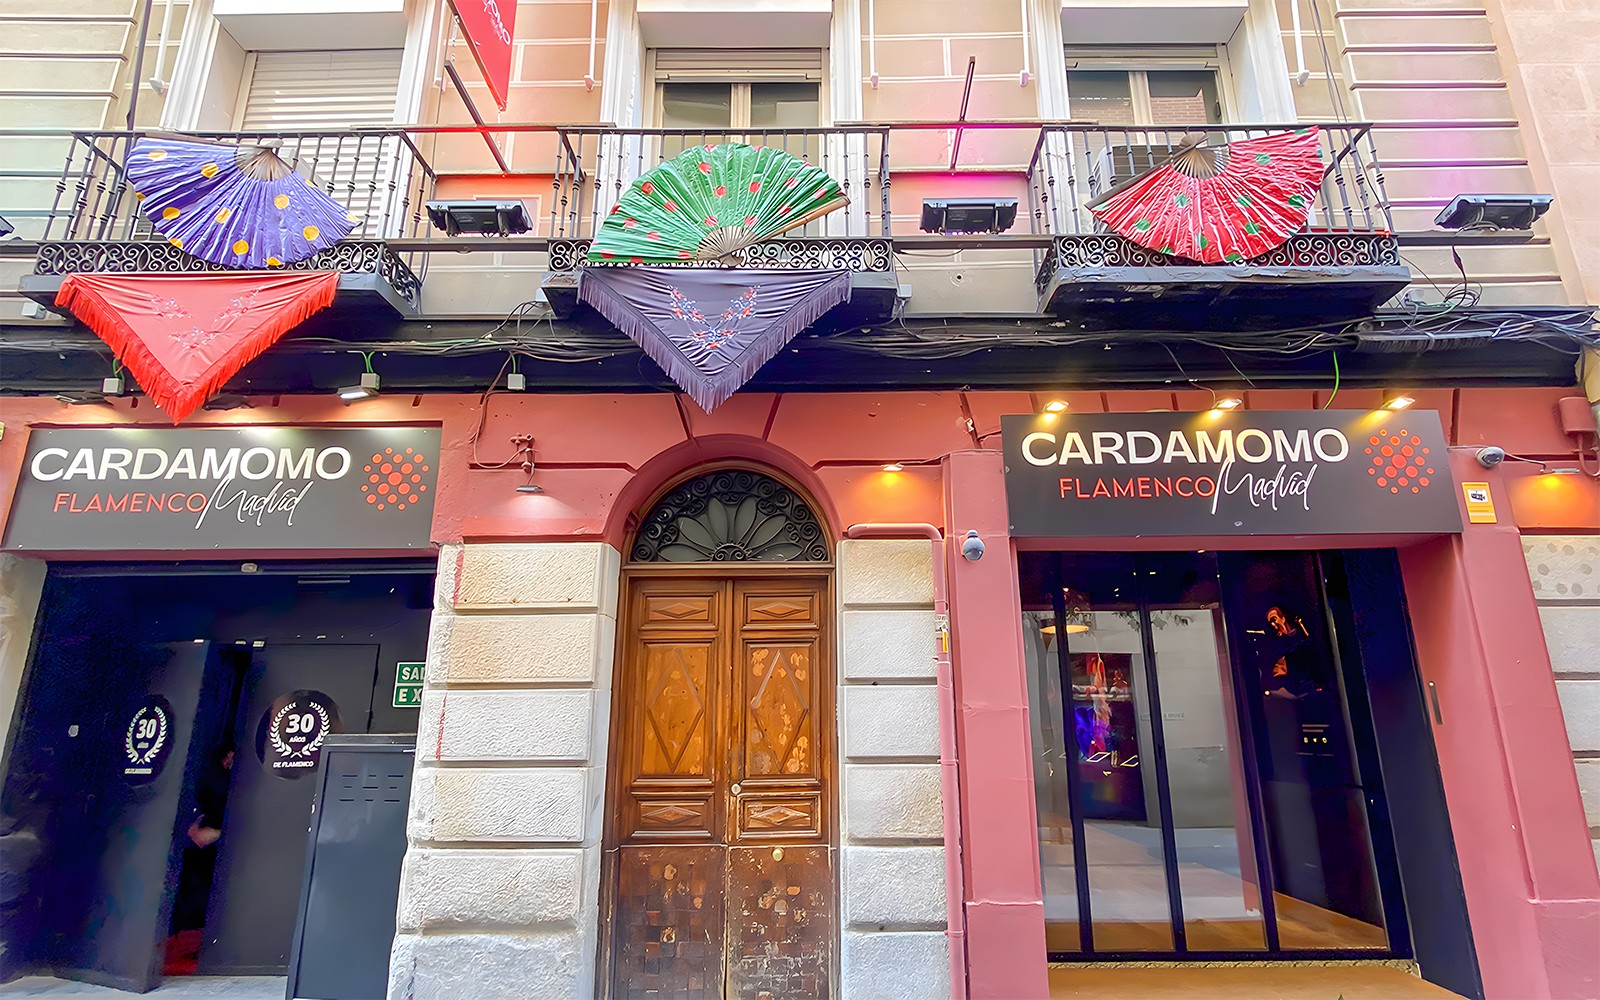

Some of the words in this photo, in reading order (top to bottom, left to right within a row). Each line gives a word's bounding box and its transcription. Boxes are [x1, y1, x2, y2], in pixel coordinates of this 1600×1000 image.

[1021, 428, 1350, 466] CARDAMOMO
[31, 446, 351, 481] CARDAMOMO
[1059, 476, 1215, 499] FLAMENCO
[53, 492, 208, 513] FLAMENCO
[136, 718, 157, 739] 30
[286, 713, 315, 734] 30
